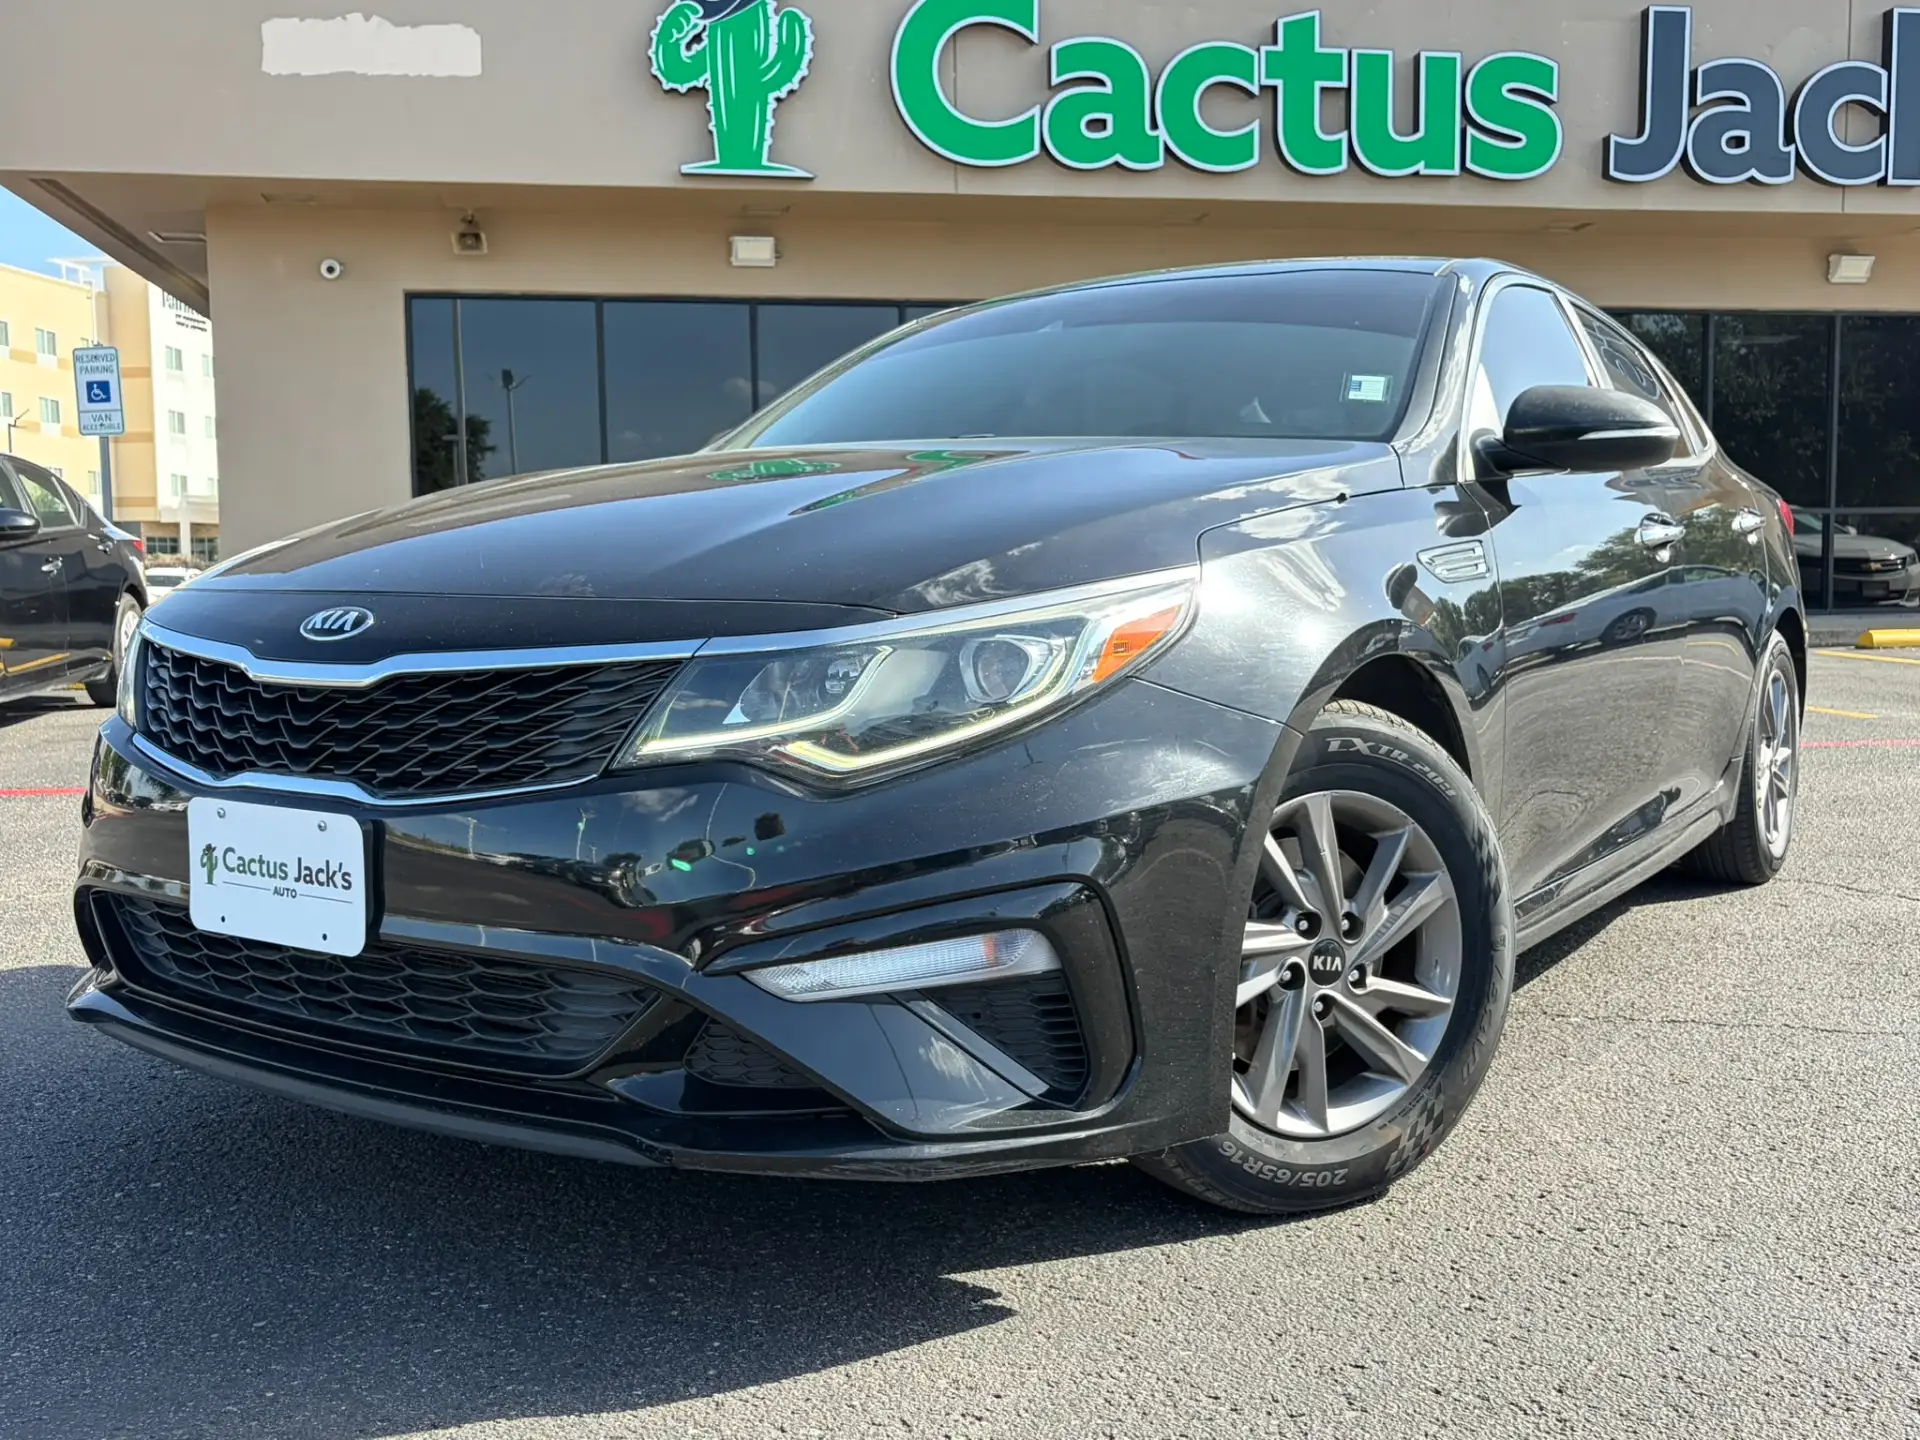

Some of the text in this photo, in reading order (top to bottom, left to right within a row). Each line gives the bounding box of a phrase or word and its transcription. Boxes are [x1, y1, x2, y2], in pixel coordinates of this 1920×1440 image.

[888, 0, 1564, 181] Cactus
[79, 364, 115, 375] PARKING
[91, 413, 112, 422] VAN
[306, 610, 359, 631] KIA
[222, 846, 353, 891] Cactus Jack's
[272, 885, 298, 899] AUTO
[1312, 955, 1342, 972] KIA
[1217, 1141, 1349, 1188] 205/65R16
